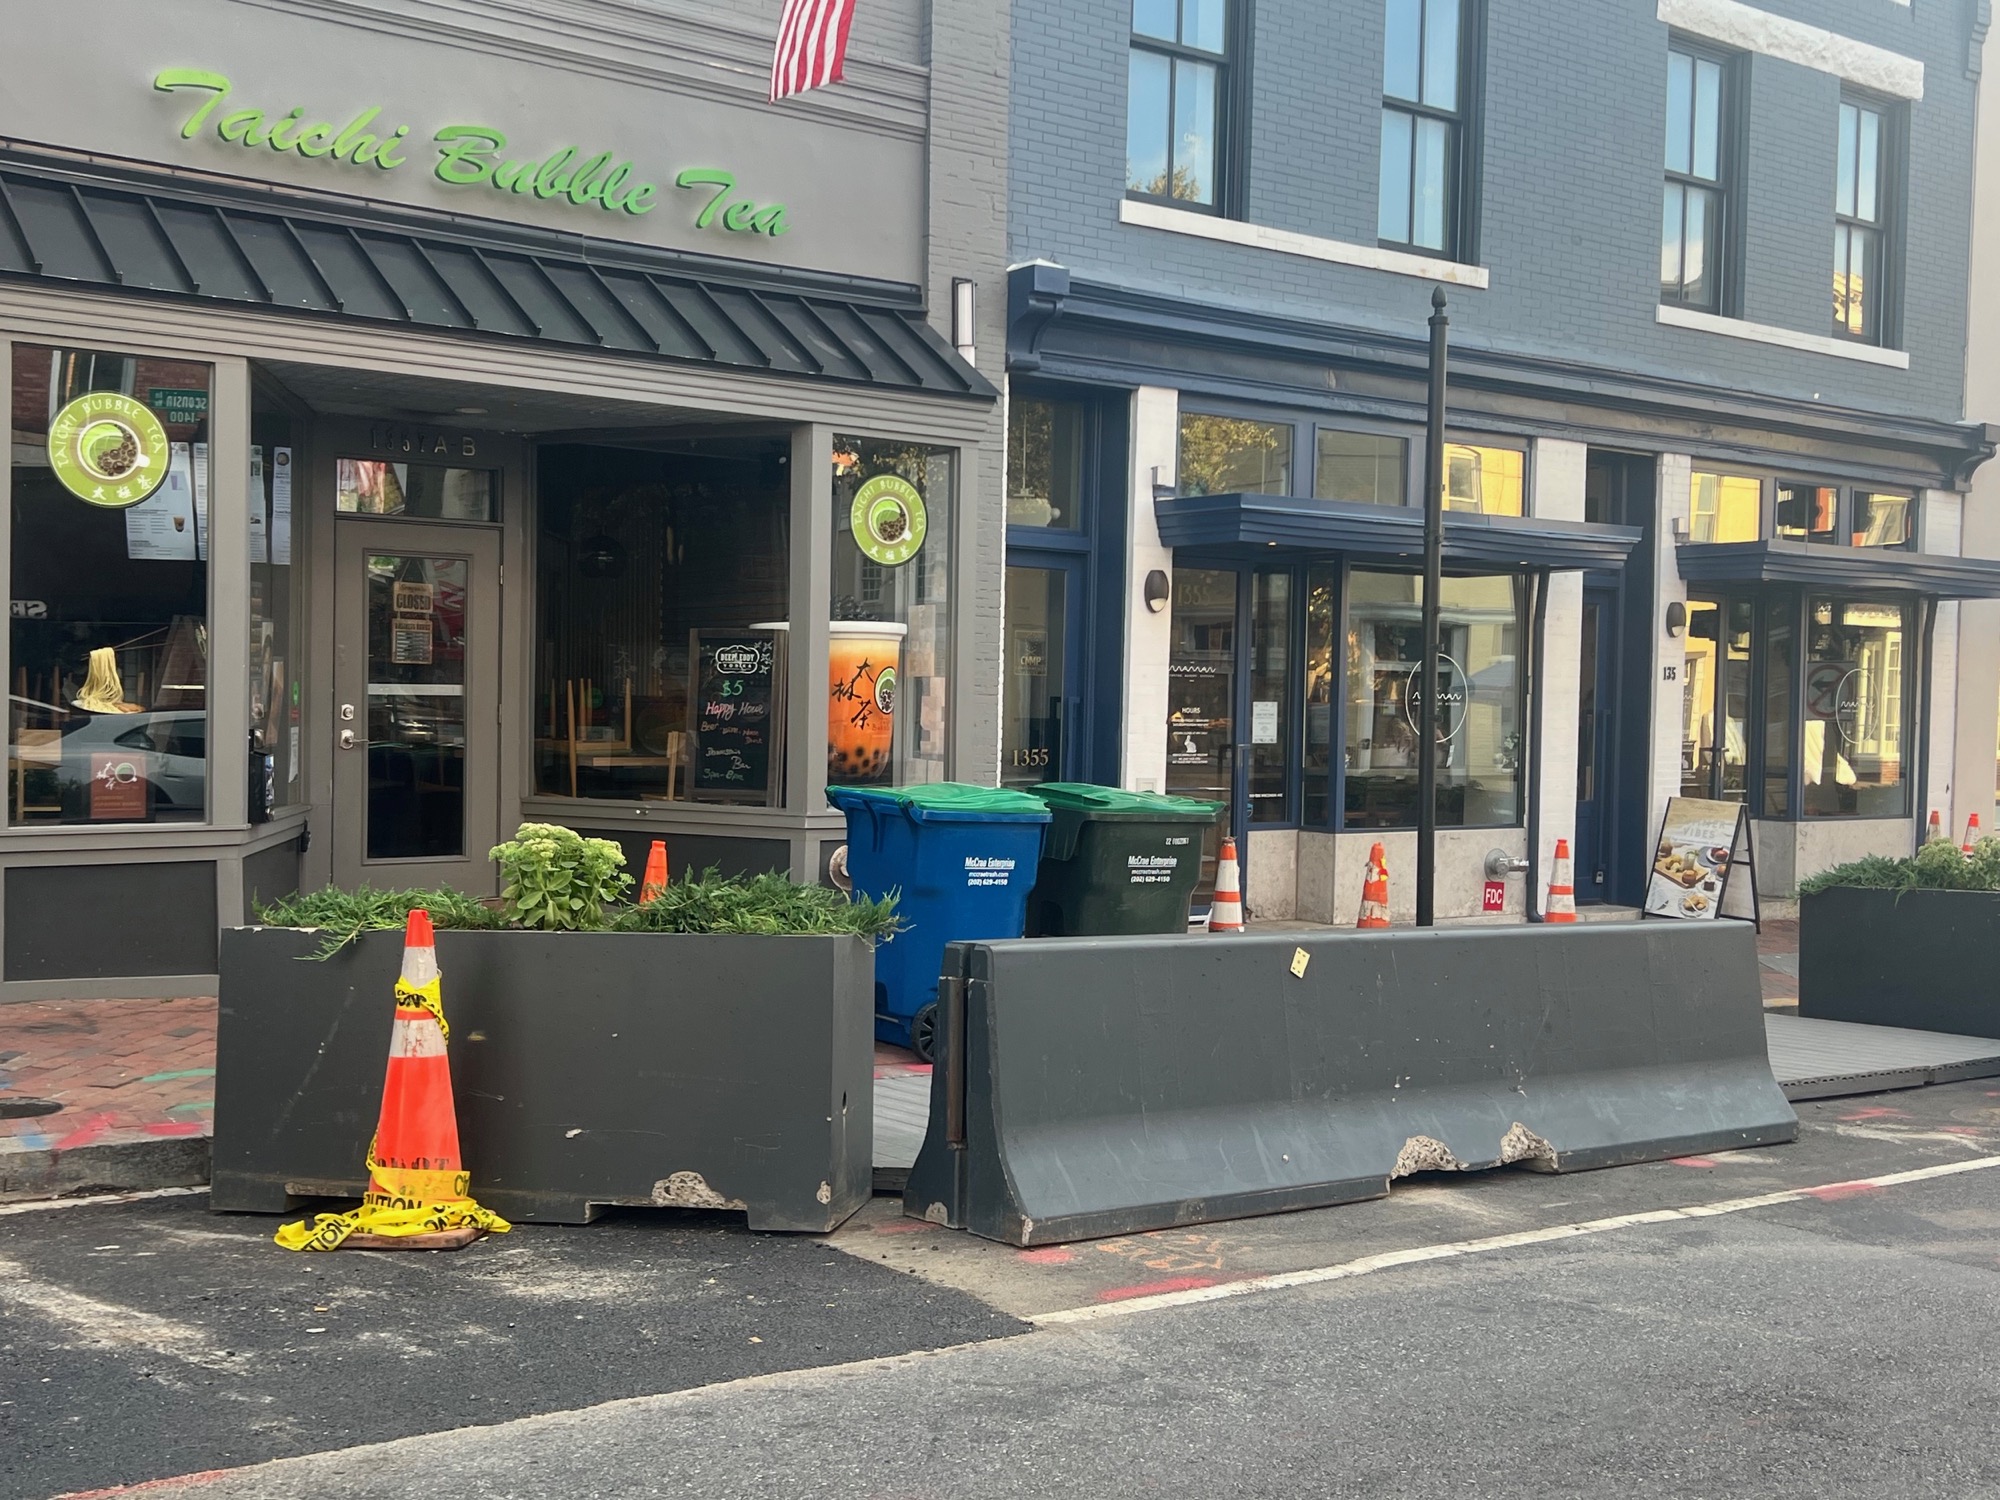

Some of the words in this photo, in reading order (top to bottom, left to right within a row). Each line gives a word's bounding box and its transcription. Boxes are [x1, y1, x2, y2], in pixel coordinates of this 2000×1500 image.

[154, 68, 408, 170] Taichi
[434, 125, 657, 215] Bubble
[676, 168, 790, 237] Tea
[54, 413, 78, 468] TAICHI
[81, 398, 142, 419] BUBBLE
[147, 423, 165, 454] TEA
[854, 485, 875, 525] TAICHI
[879, 480, 916, 503] BUBBLE
[915, 509, 924, 532] TEA
[739, 653, 755, 662] EDDY
[720, 679, 744, 697] $5
[705, 701, 737, 721] Happy
[1013, 749, 1049, 767] 1355
[1683, 827, 1716, 839] VIBES
[1485, 888, 1503, 905] FDC
